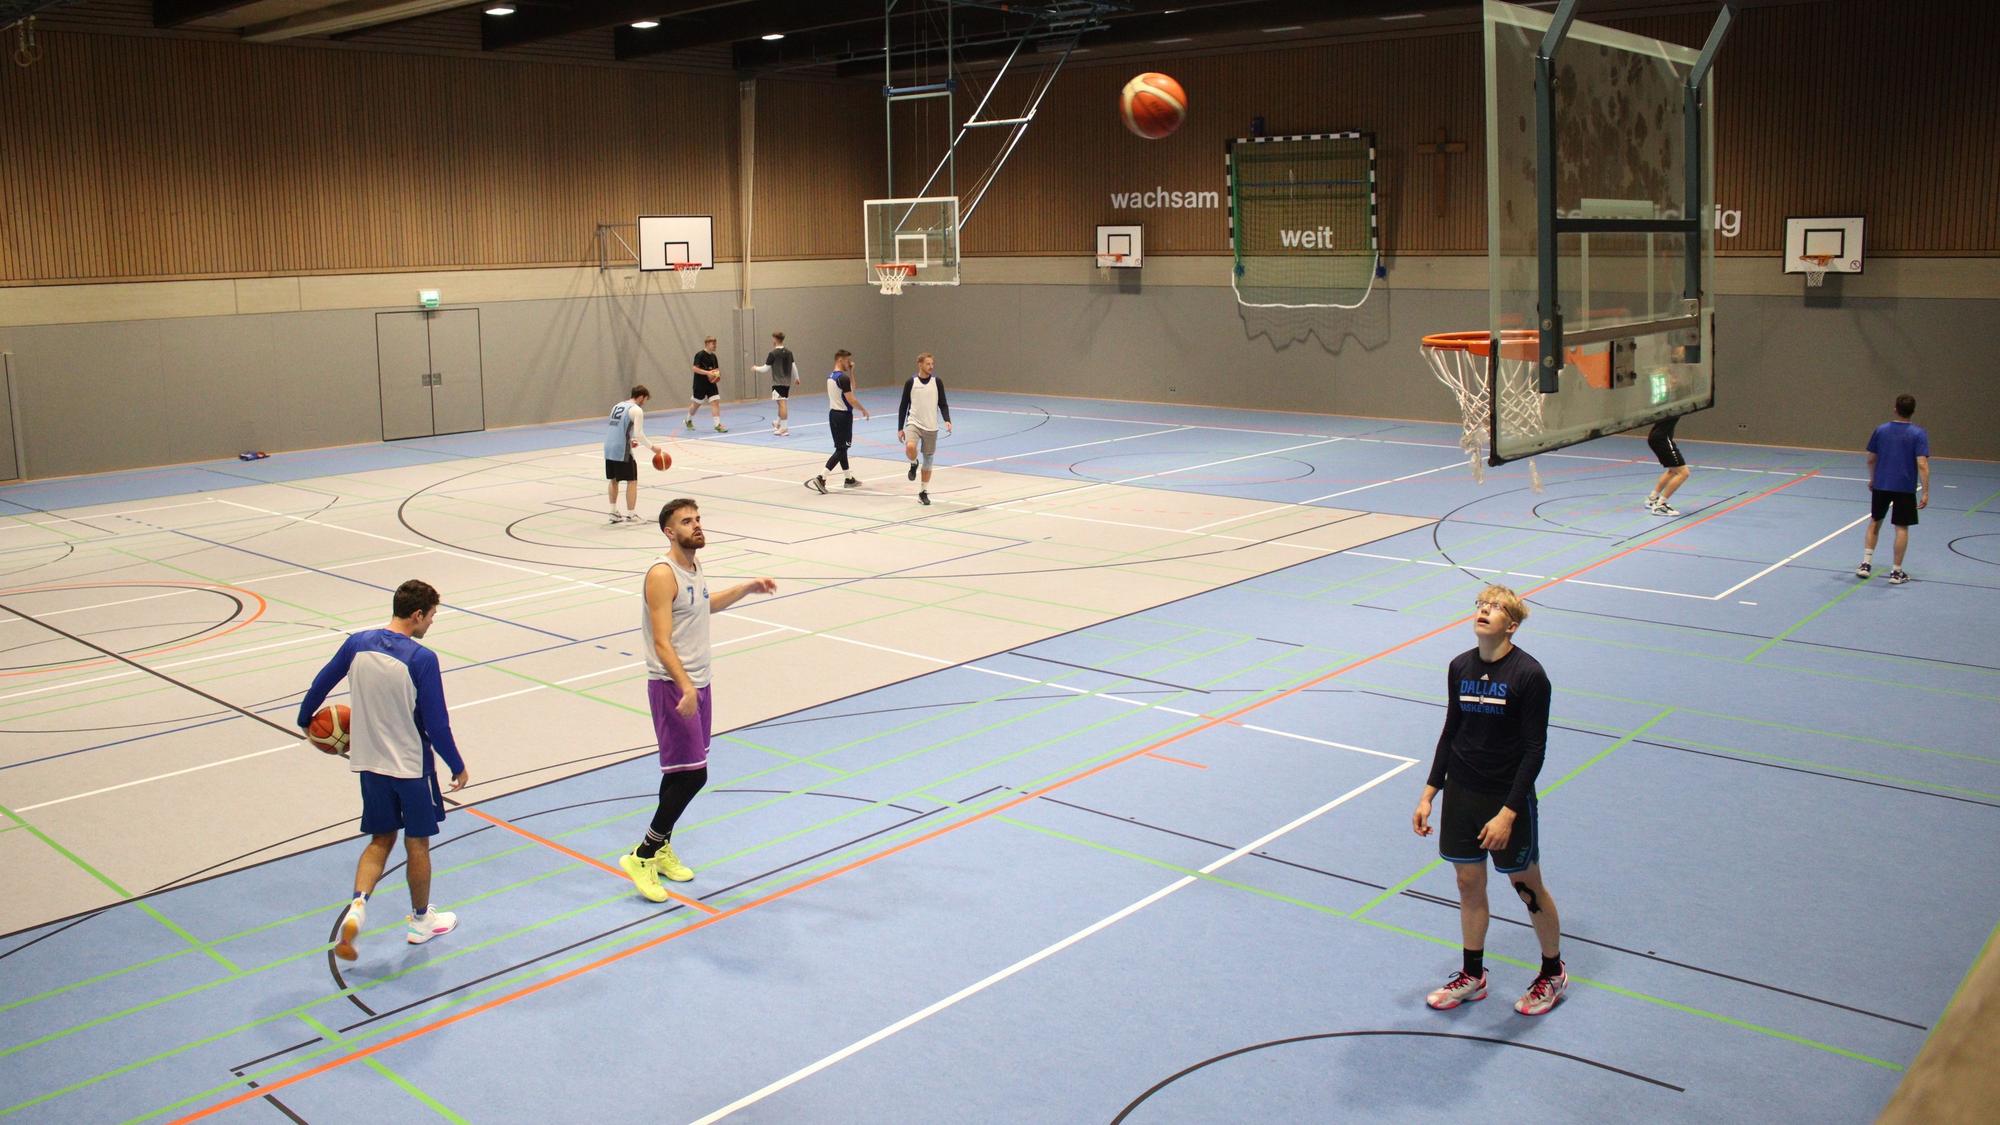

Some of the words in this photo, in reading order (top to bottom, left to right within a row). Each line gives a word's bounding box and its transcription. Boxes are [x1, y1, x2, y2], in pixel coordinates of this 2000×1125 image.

[1111, 186, 1219, 209] wachsam
[1280, 226, 1333, 248] weit
[611, 406, 625, 420] 12
[687, 586, 694, 605] 7
[1460, 679, 1507, 697] DALLAS
